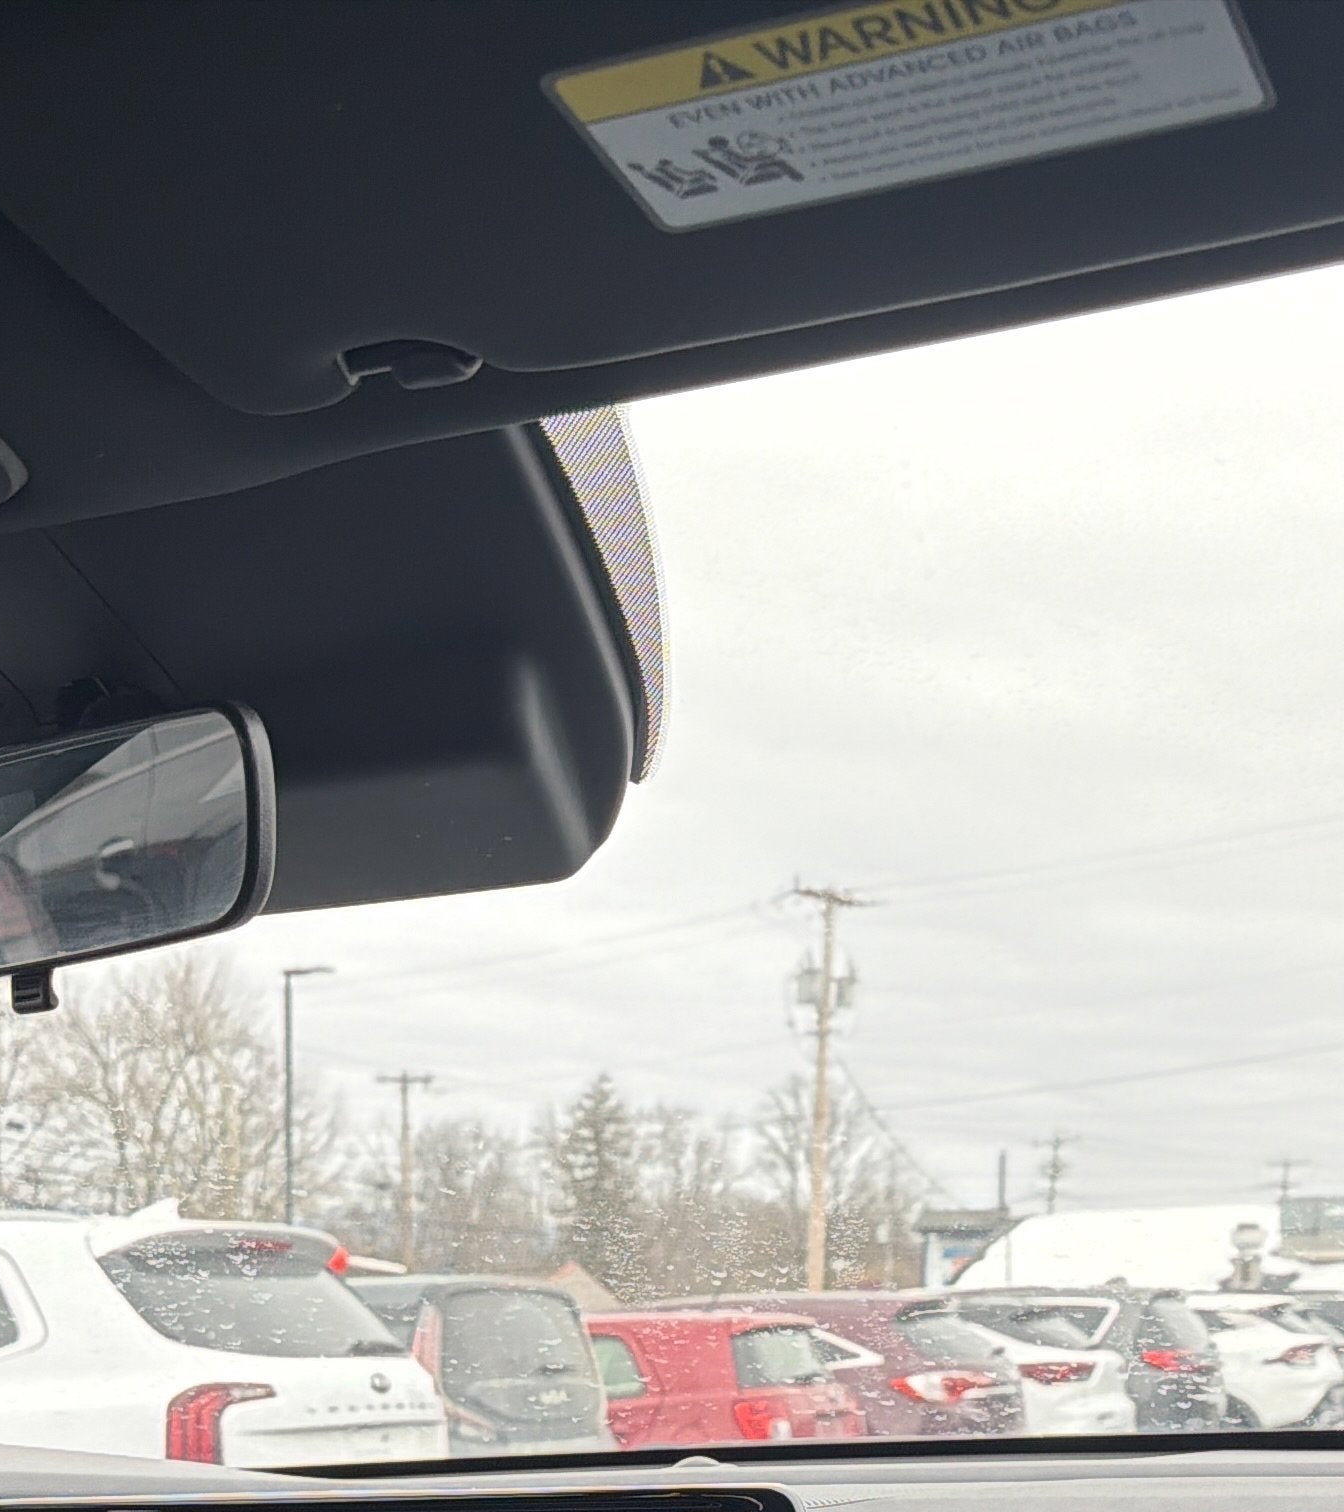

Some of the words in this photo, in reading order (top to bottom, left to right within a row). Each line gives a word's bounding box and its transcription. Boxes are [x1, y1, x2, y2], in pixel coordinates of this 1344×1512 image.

[746, 81, 820, 111] WITH
[829, 43, 988, 94] ADVANCED
[998, 31, 1045, 56] AIR
[1053, 10, 1137, 43] BAGS
